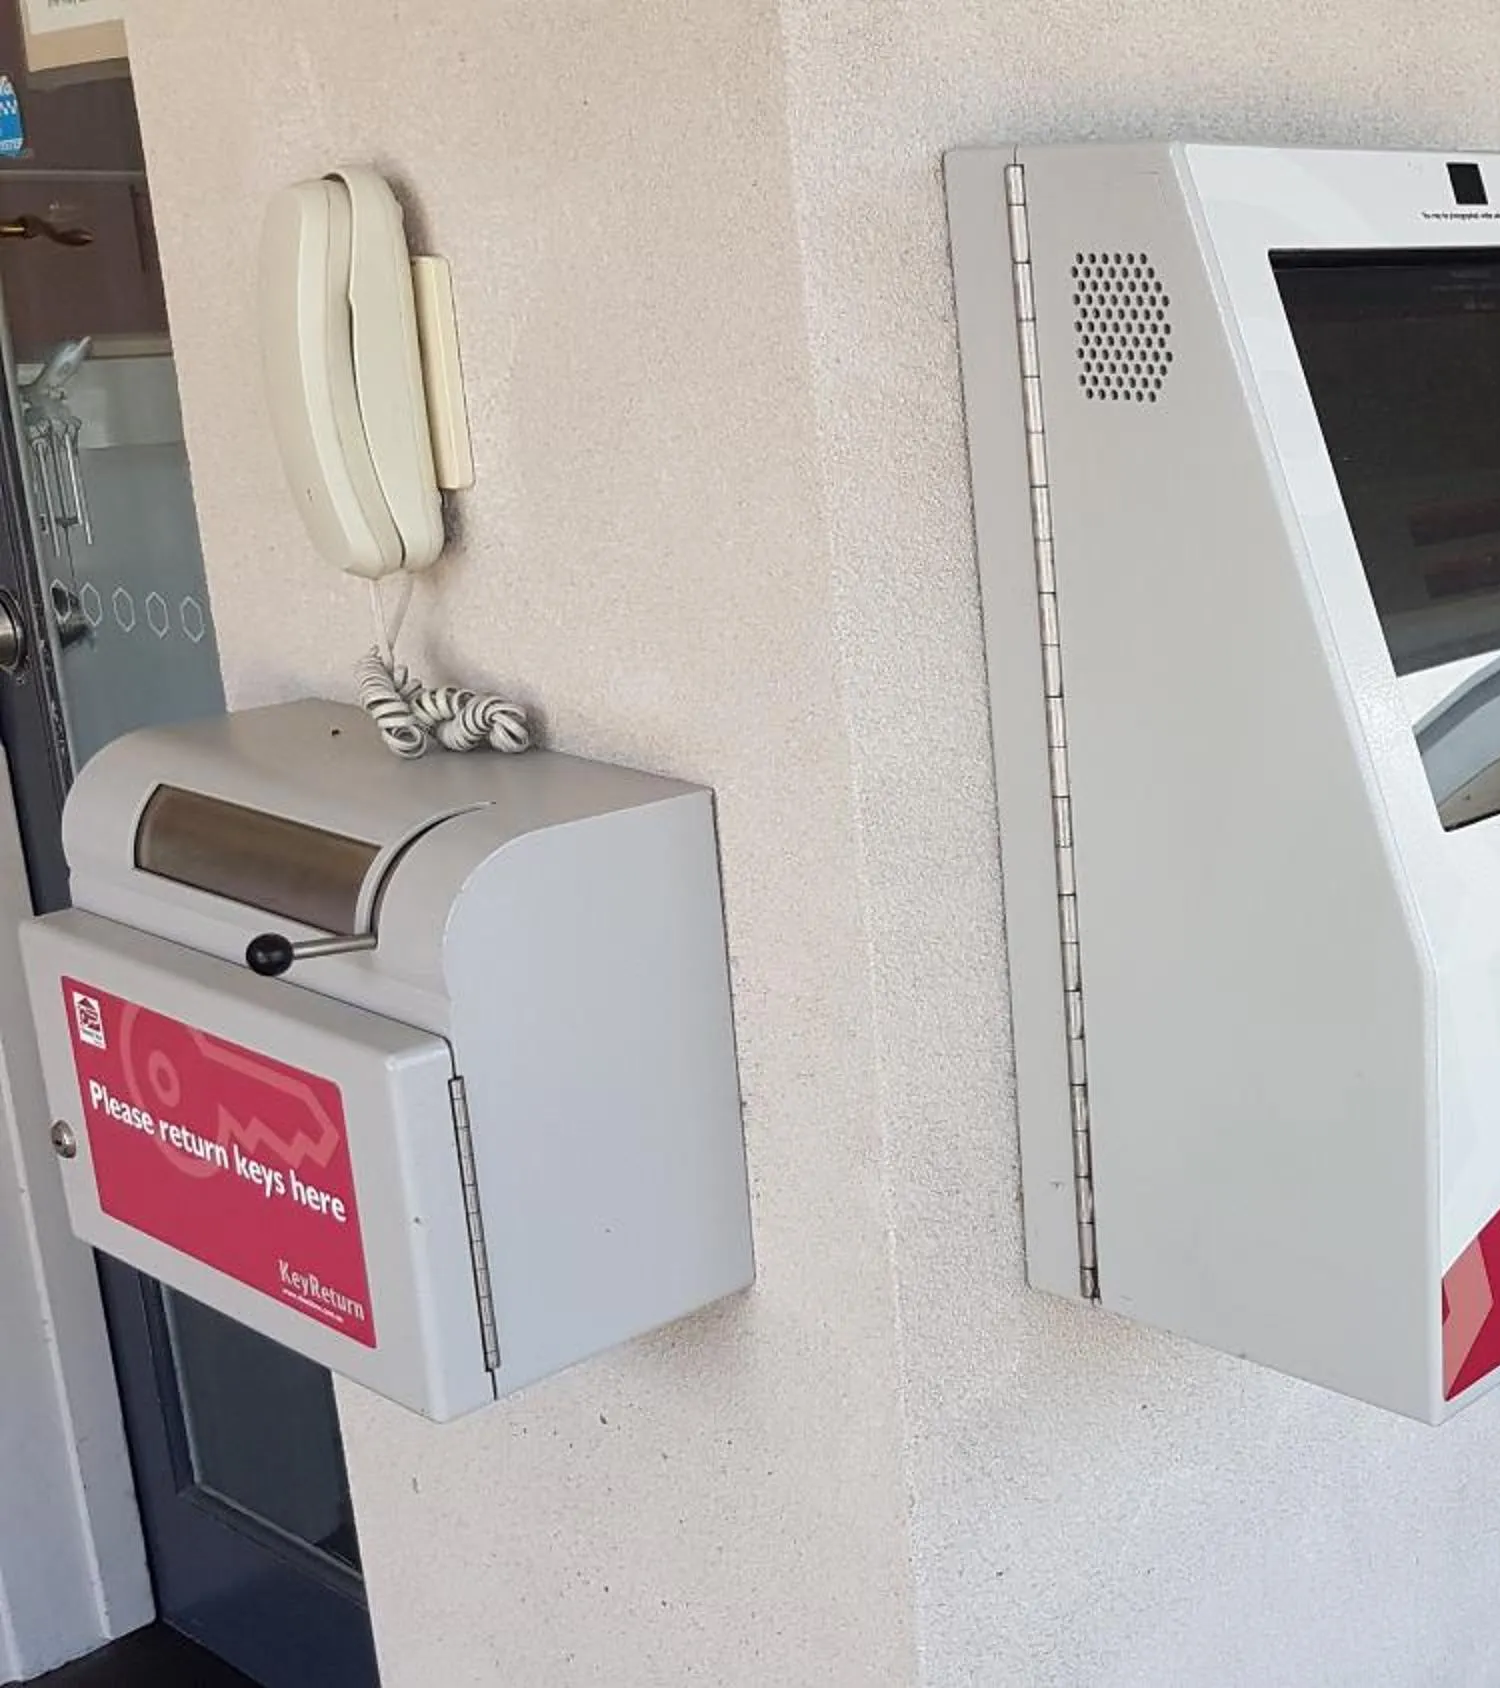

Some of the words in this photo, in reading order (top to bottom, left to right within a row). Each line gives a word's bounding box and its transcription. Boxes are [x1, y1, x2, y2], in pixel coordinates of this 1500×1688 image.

[89, 1079, 155, 1135] Please
[159, 1119, 229, 1169] return
[233, 1143, 286, 1198] keys
[289, 1168, 347, 1223] here
[278, 1258, 365, 1321] KeyReturn
